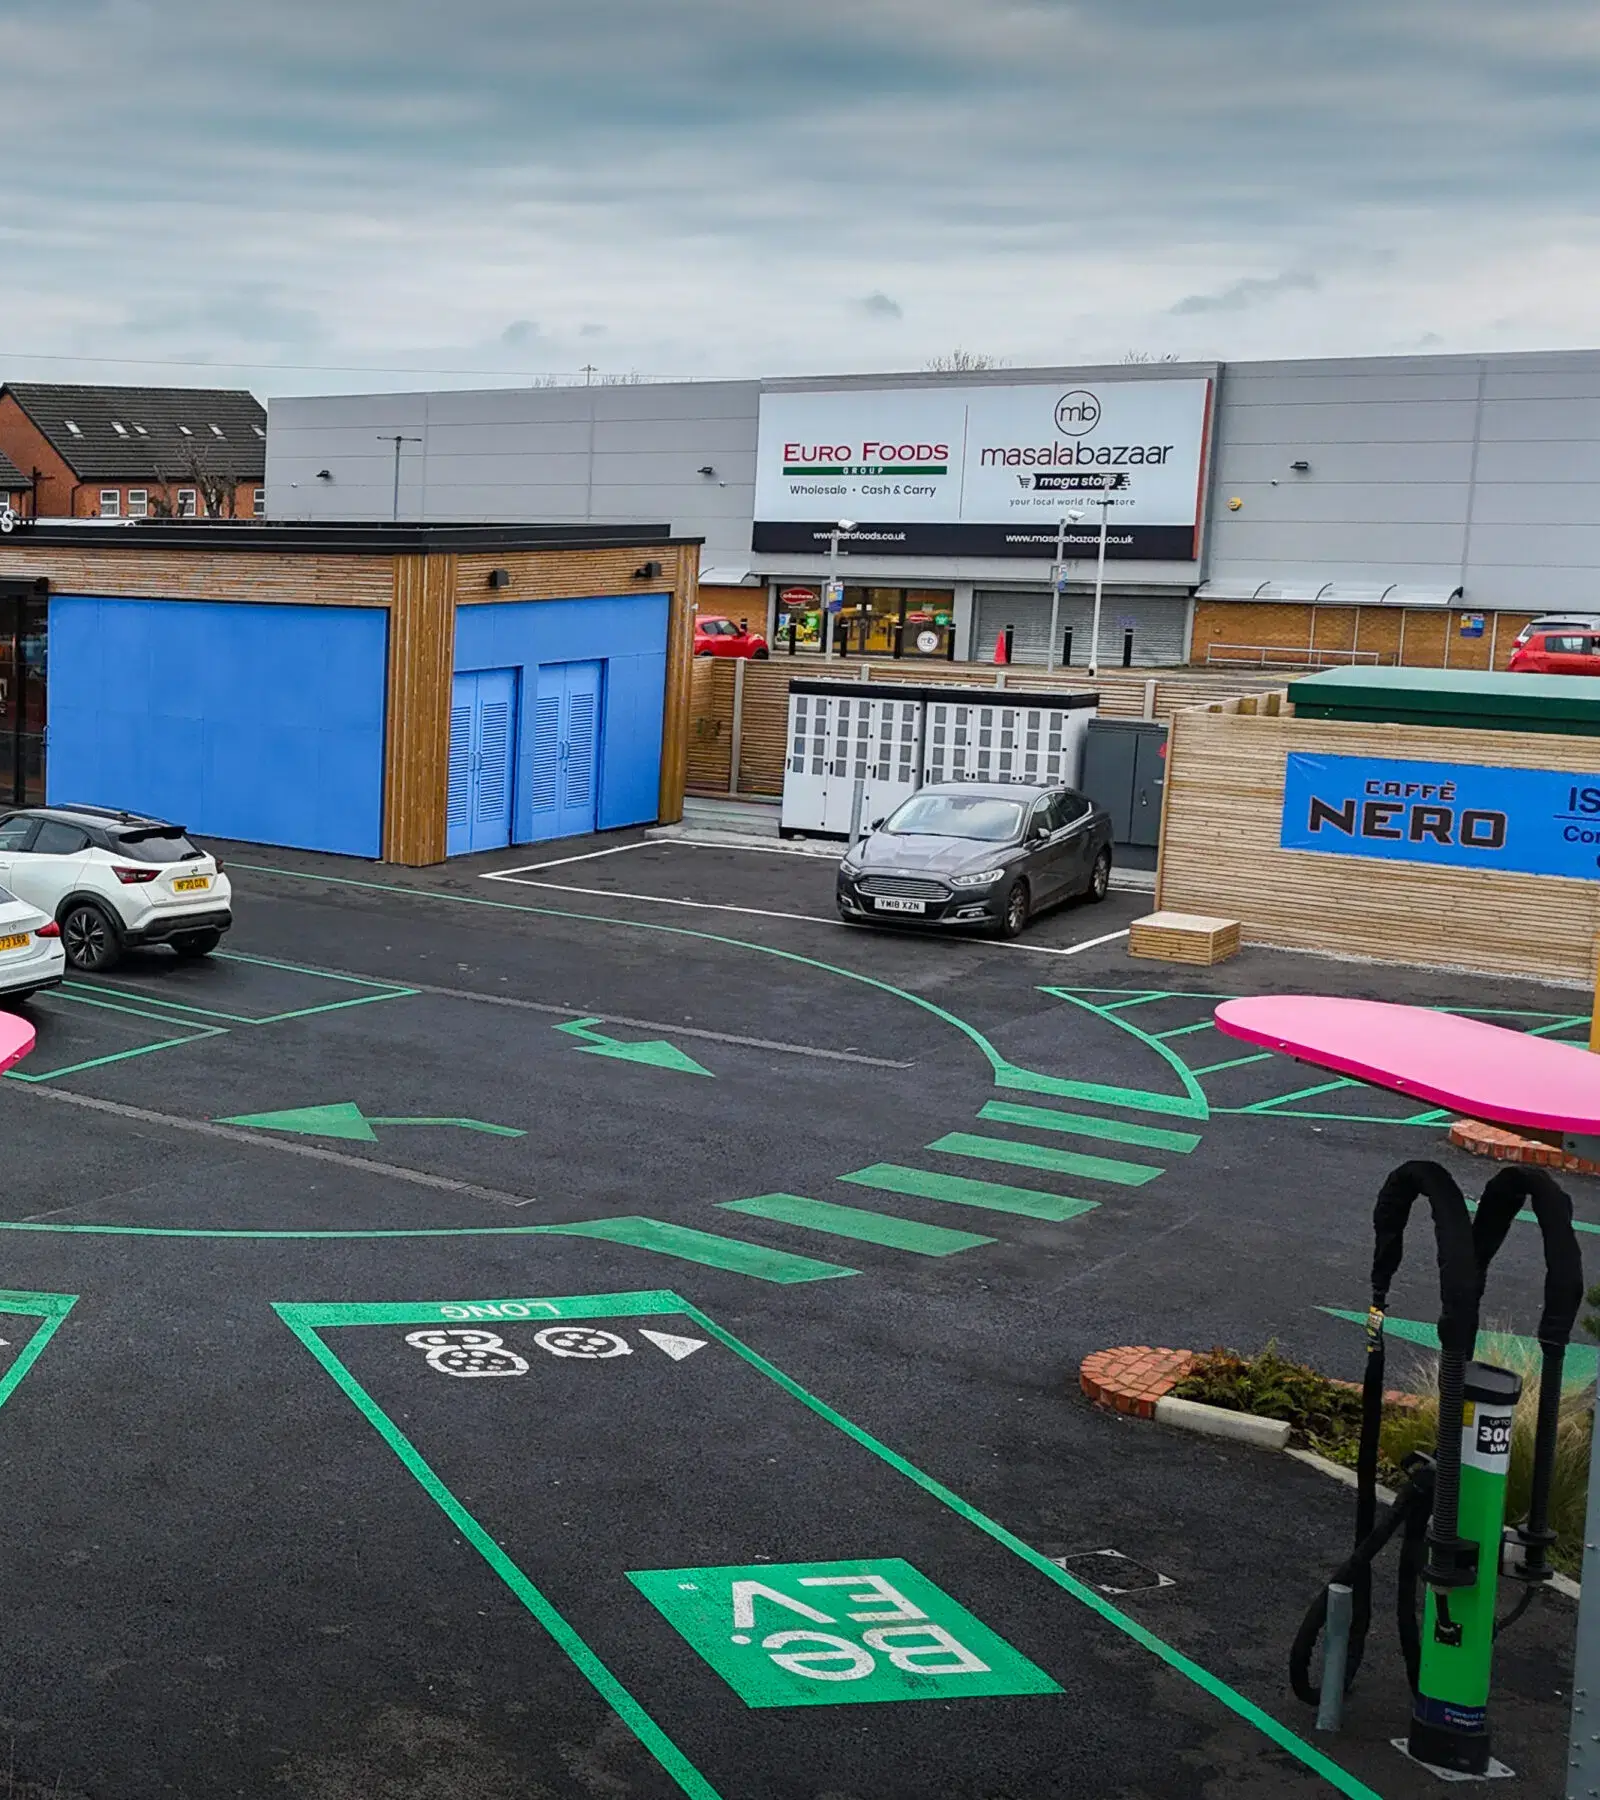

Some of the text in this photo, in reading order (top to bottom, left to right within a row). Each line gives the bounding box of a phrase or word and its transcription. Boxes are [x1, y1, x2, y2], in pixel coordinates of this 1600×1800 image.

[1060, 402, 1097, 422] mb
[784, 442, 949, 462] EURO FOODS
[980, 441, 1174, 466] masalabazaar
[843, 467, 884, 475] GROUP
[790, 485, 848, 495] Wholesale
[861, 485, 892, 495] Cash
[903, 485, 937, 498] Carry
[1040, 476, 1078, 489] mega
[1010, 499, 1031, 507] your
[1057, 498, 1083, 506] world
[1365, 781, 1456, 800] CAFFÈ
[1309, 796, 1507, 849] NERO
[440, 1301, 561, 1319] LONG
[1490, 1443, 1507, 1452] kW
[731, 1575, 929, 1628] EV
